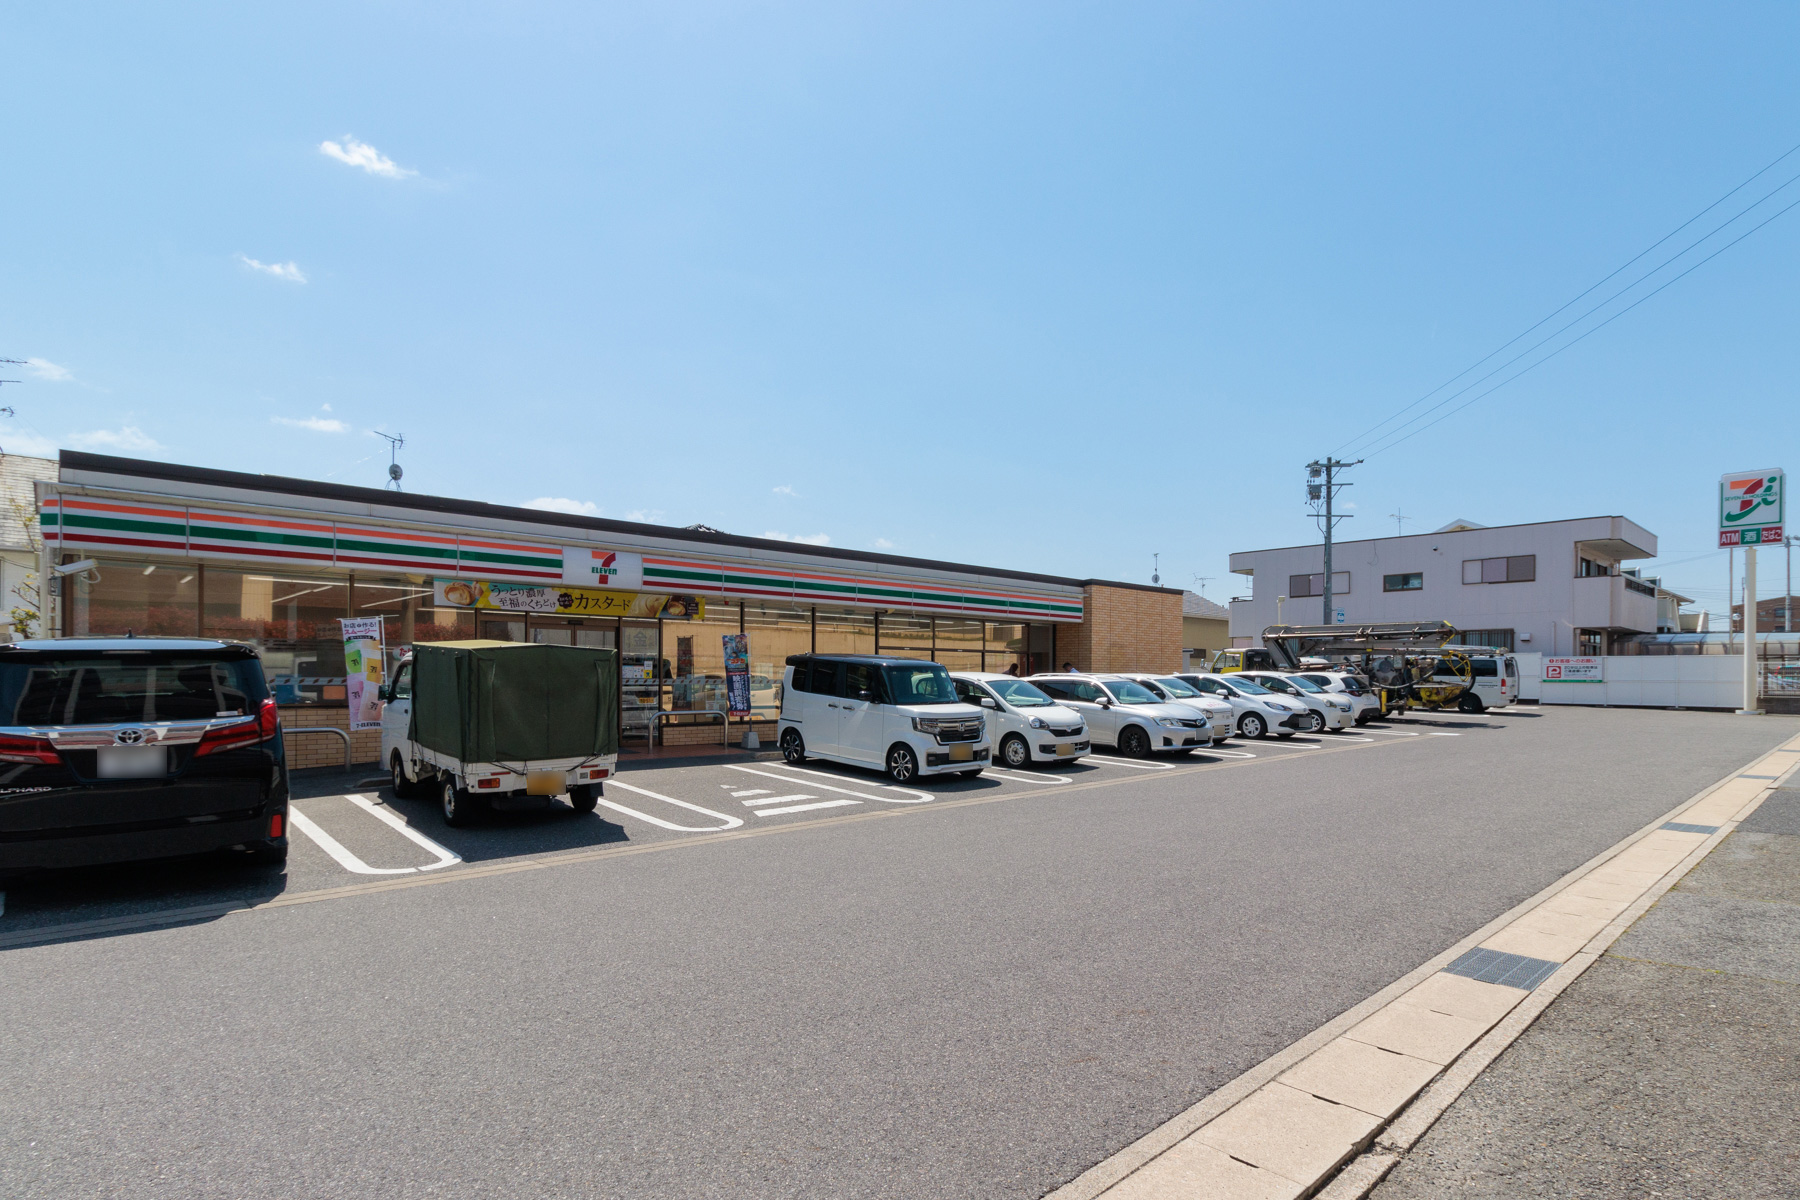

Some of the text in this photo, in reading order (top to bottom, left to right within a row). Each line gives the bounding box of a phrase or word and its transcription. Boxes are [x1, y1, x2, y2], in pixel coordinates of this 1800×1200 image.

[1721, 533, 1739, 543] ATM
[1744, 531, 1757, 542] 酒
[1762, 529, 1782, 540] たばこ
[491, 584, 546, 598] うっとり濃厚
[498, 597, 556, 610] 至福のくちどけ
[575, 593, 631, 611] カスタード
